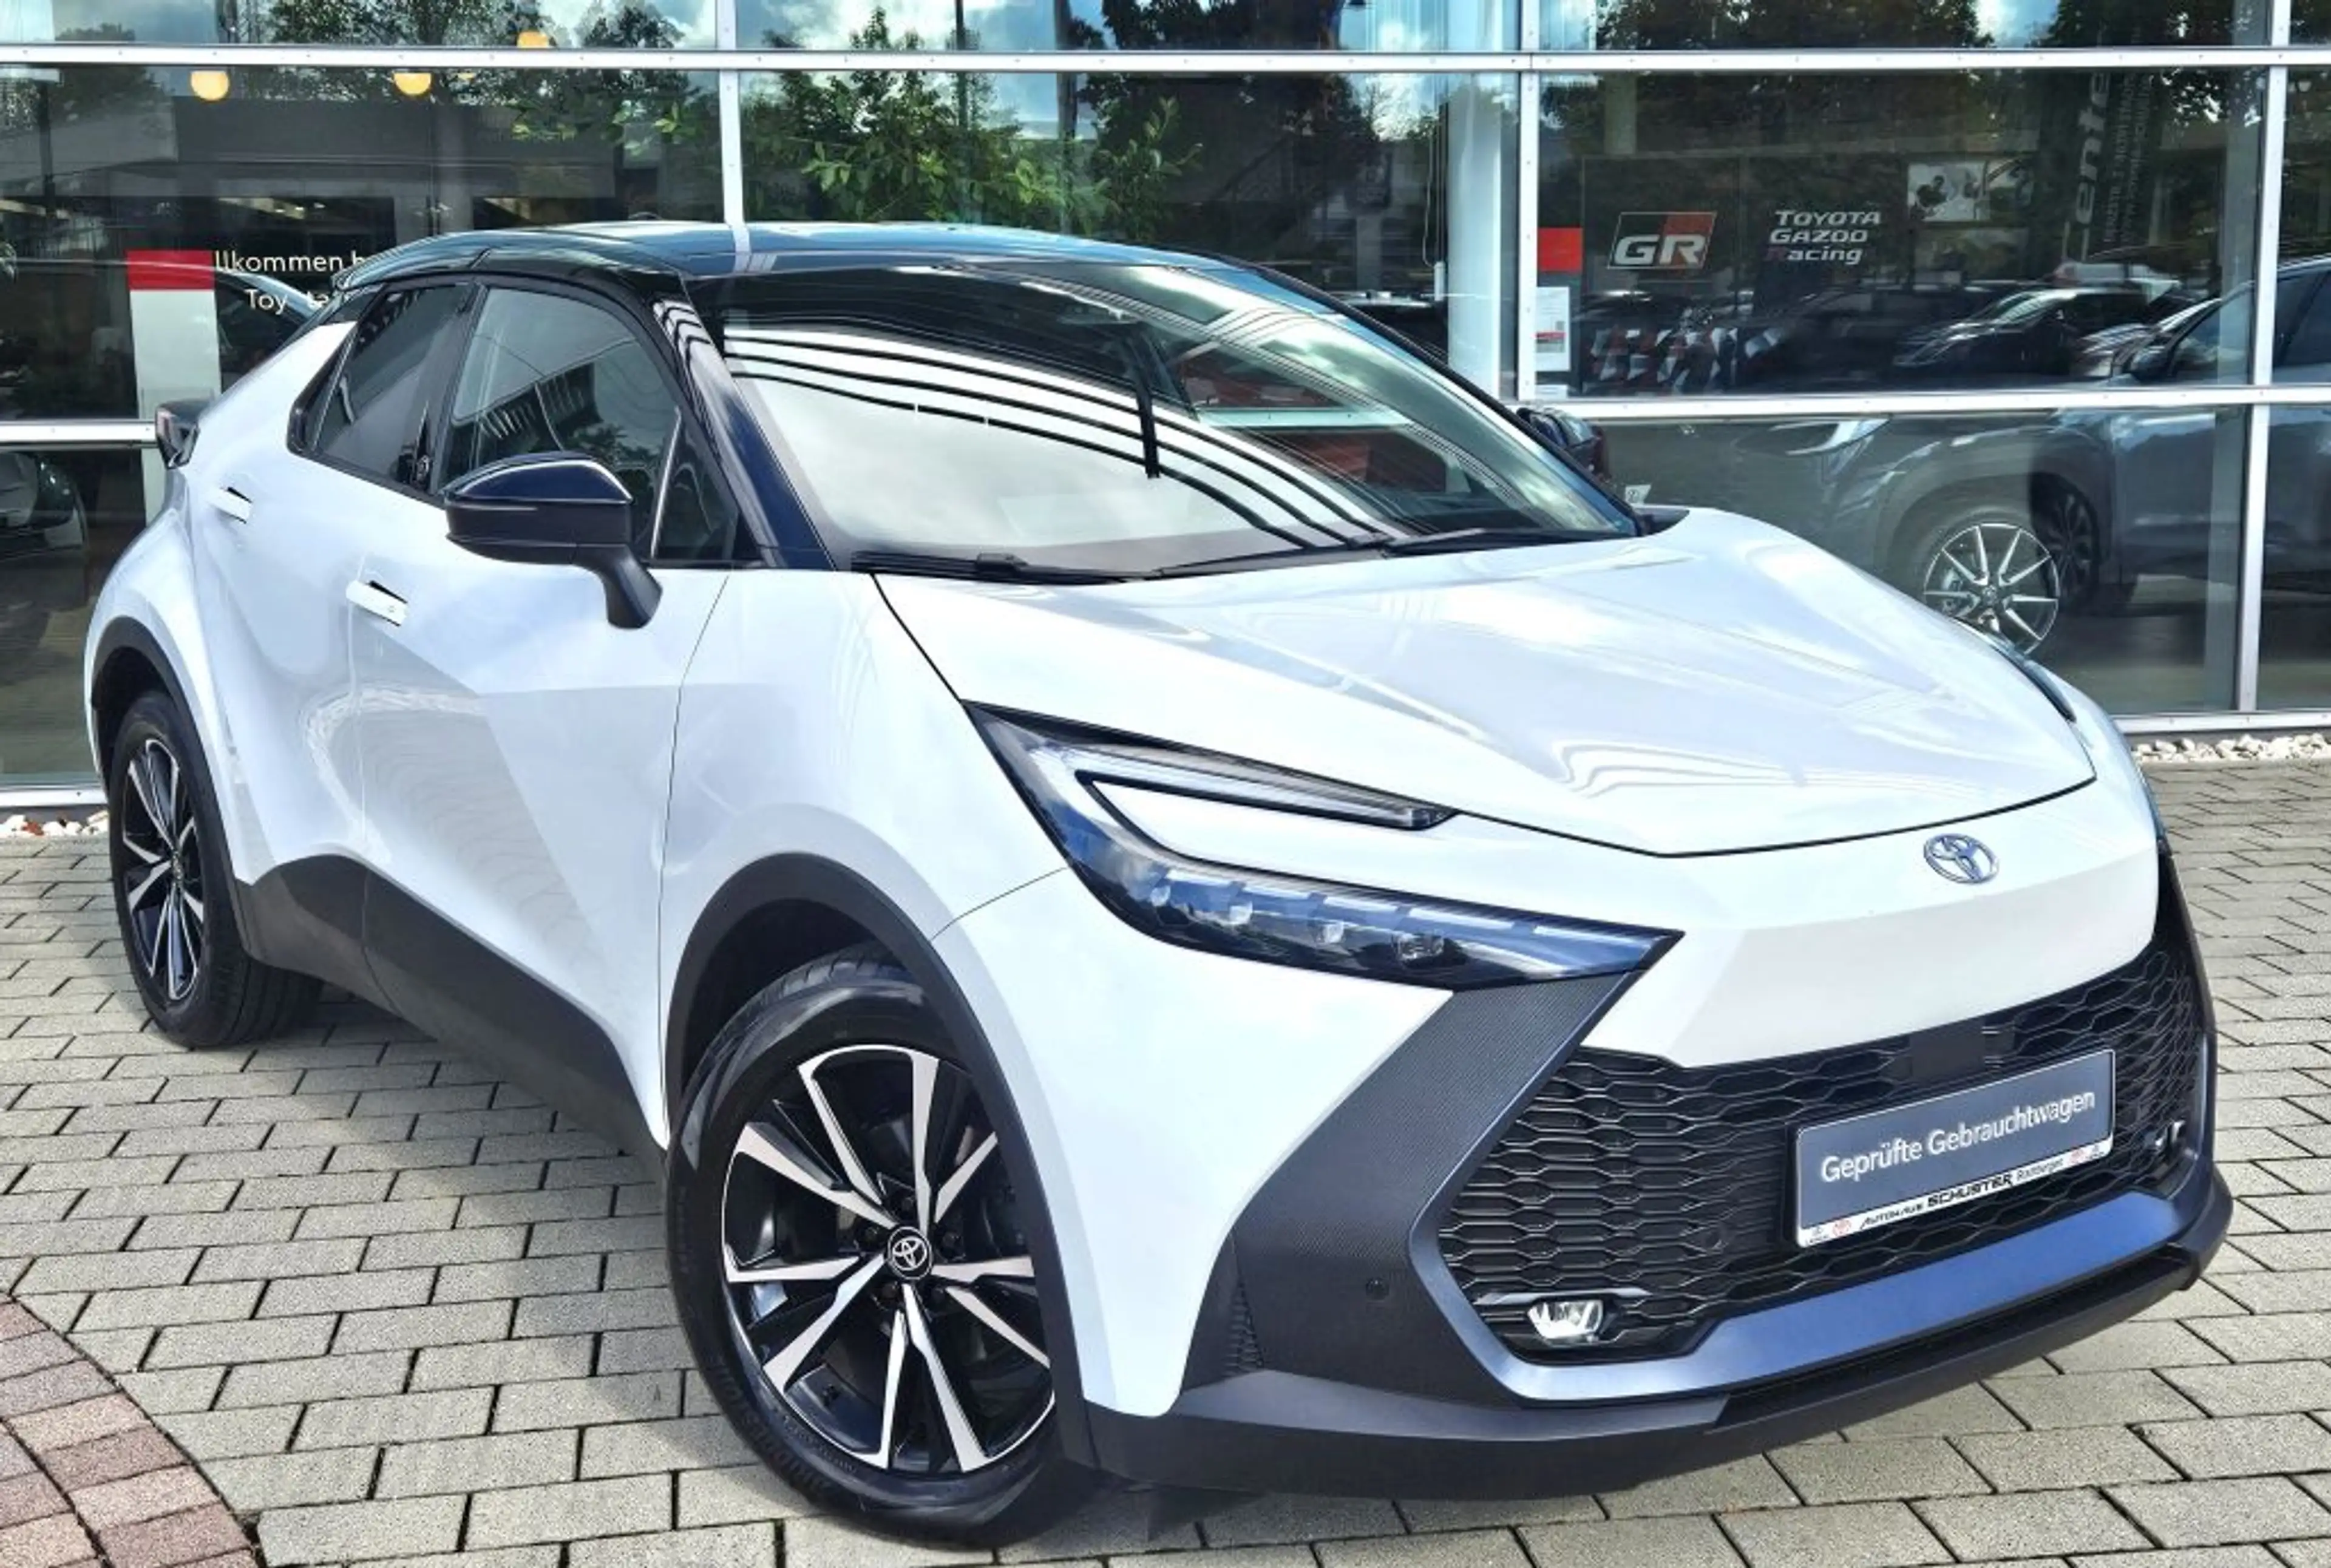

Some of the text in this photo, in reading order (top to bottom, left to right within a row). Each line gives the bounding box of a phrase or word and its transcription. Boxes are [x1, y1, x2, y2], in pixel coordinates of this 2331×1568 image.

[1776, 211, 1881, 226] TOYOTA
[1769, 228, 1868, 243] GAZOO
[215, 249, 344, 272] llkommen
[1615, 234, 1706, 265] GR
[1822, 1091, 2095, 1182] Geprüfte Gebrauchtwagen
[1928, 1173, 2014, 1207] SCHUSTER
